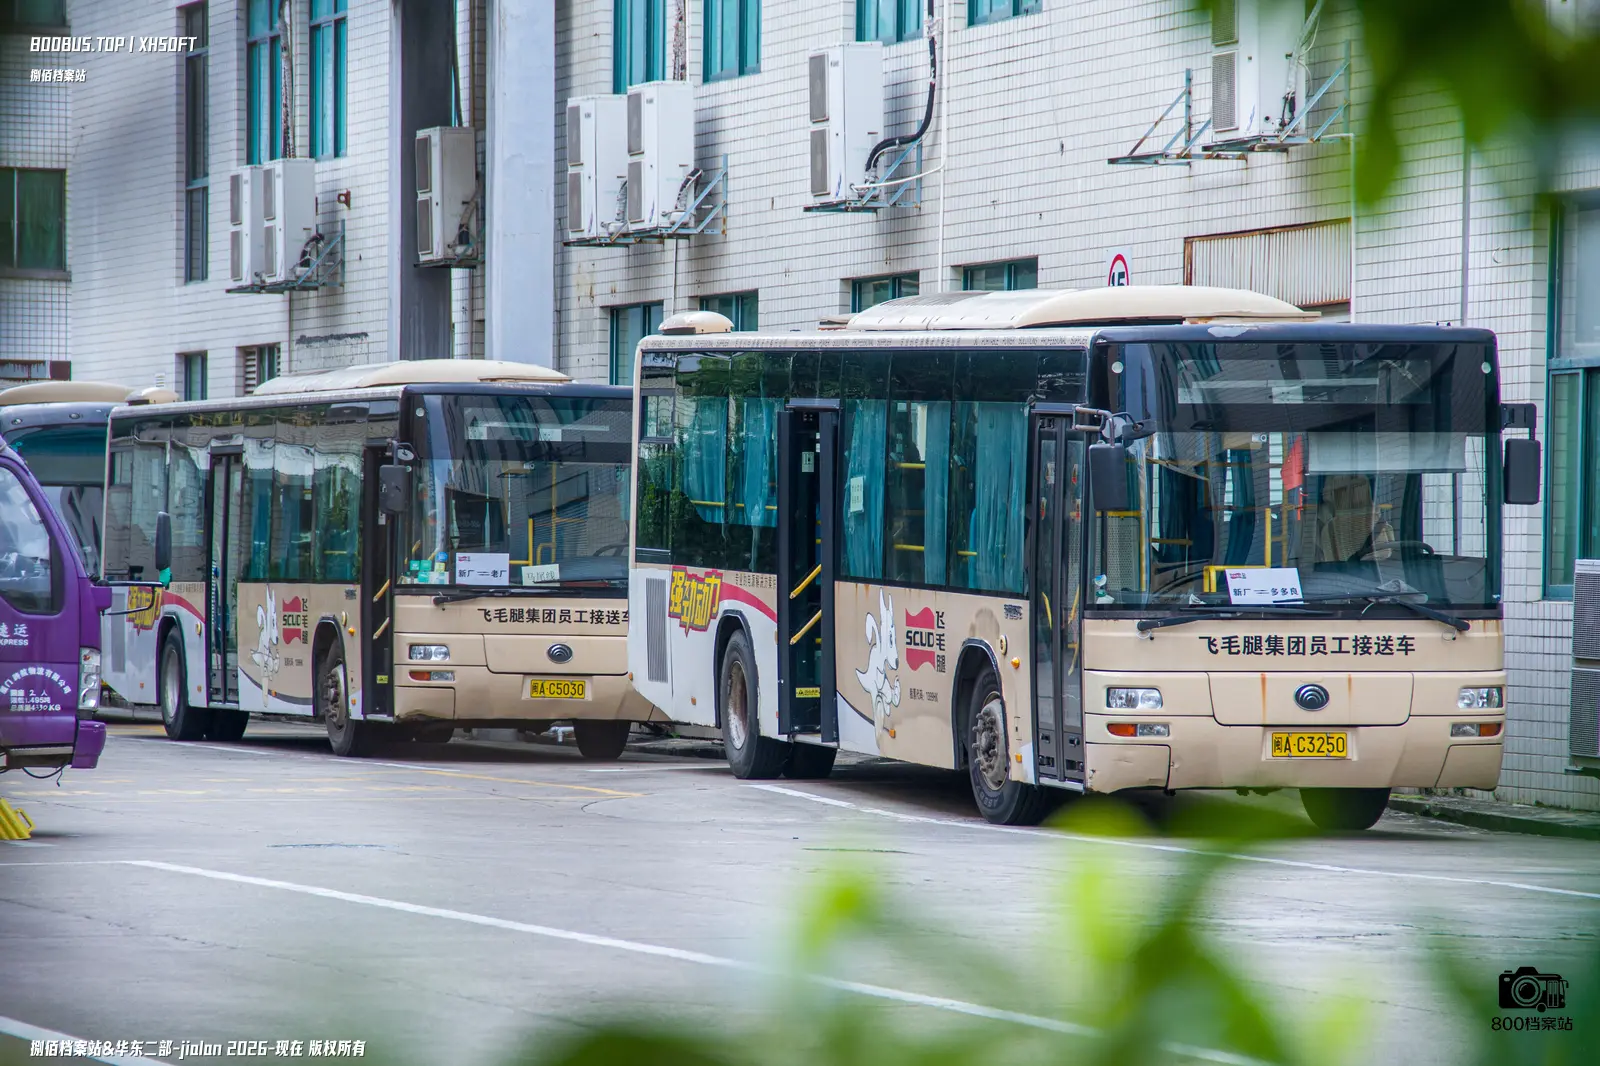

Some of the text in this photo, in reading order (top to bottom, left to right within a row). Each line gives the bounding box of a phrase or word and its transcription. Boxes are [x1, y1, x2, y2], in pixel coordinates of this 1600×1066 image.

[905, 630, 935, 648] SCUD
[1198, 634, 1416, 656] 飞毛腿集团员工接送车
[1273, 735, 1347, 755] 闽A·C3250
